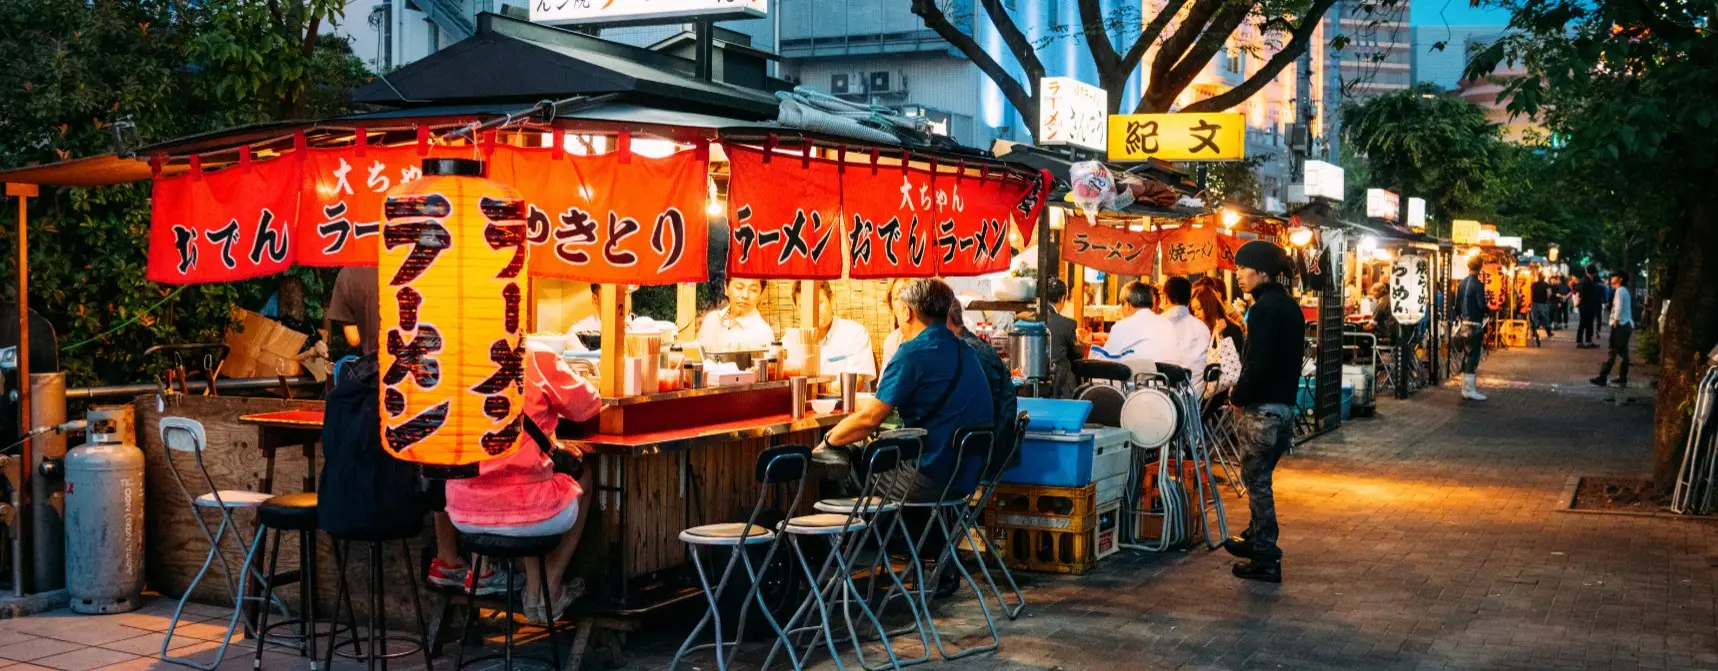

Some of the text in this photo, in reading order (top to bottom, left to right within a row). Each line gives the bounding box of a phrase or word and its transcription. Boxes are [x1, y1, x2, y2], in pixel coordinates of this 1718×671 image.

[1046, 80, 1061, 141] ラーメン
[1125, 119, 1223, 156] 紀文
[898, 175, 965, 214] 大ちゃん
[733, 203, 840, 264] ラーメン
[849, 214, 927, 268] おでん
[936, 217, 1008, 265] ラーメン
[1072, 233, 1145, 262] ラーメン
[1168, 242, 1214, 263] 焼ラーメン
[1391, 260, 1410, 314] らーめん
[380, 193, 453, 453] ラーメン
[467, 195, 527, 456] ラーメン
